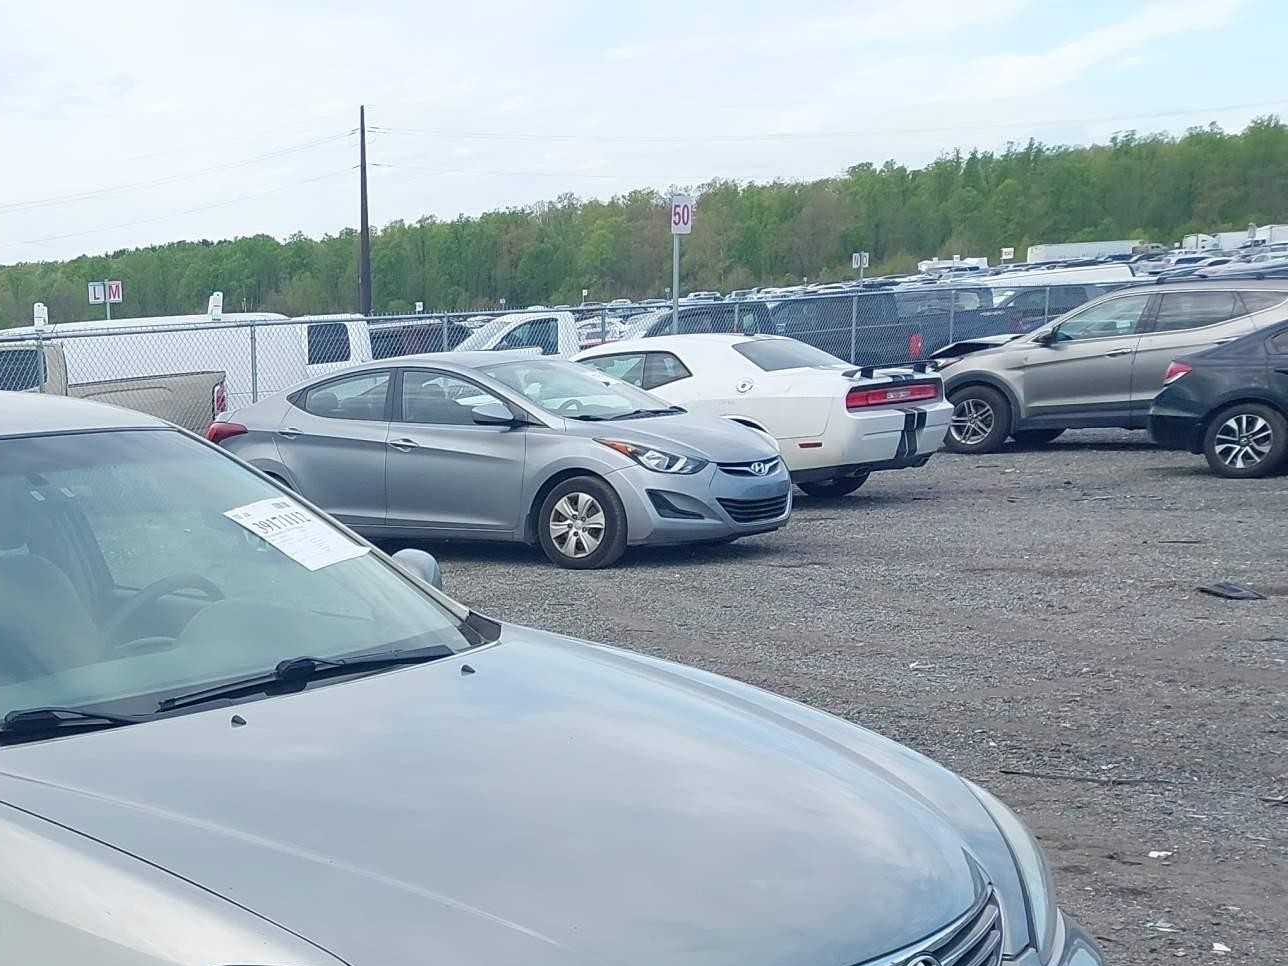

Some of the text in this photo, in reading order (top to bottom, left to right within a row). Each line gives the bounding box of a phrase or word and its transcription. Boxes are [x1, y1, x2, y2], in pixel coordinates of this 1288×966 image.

[673, 204, 689, 226] 50
[93, 285, 101, 300] L
[108, 284, 121, 300] M
[252, 511, 312, 535] 39171112
